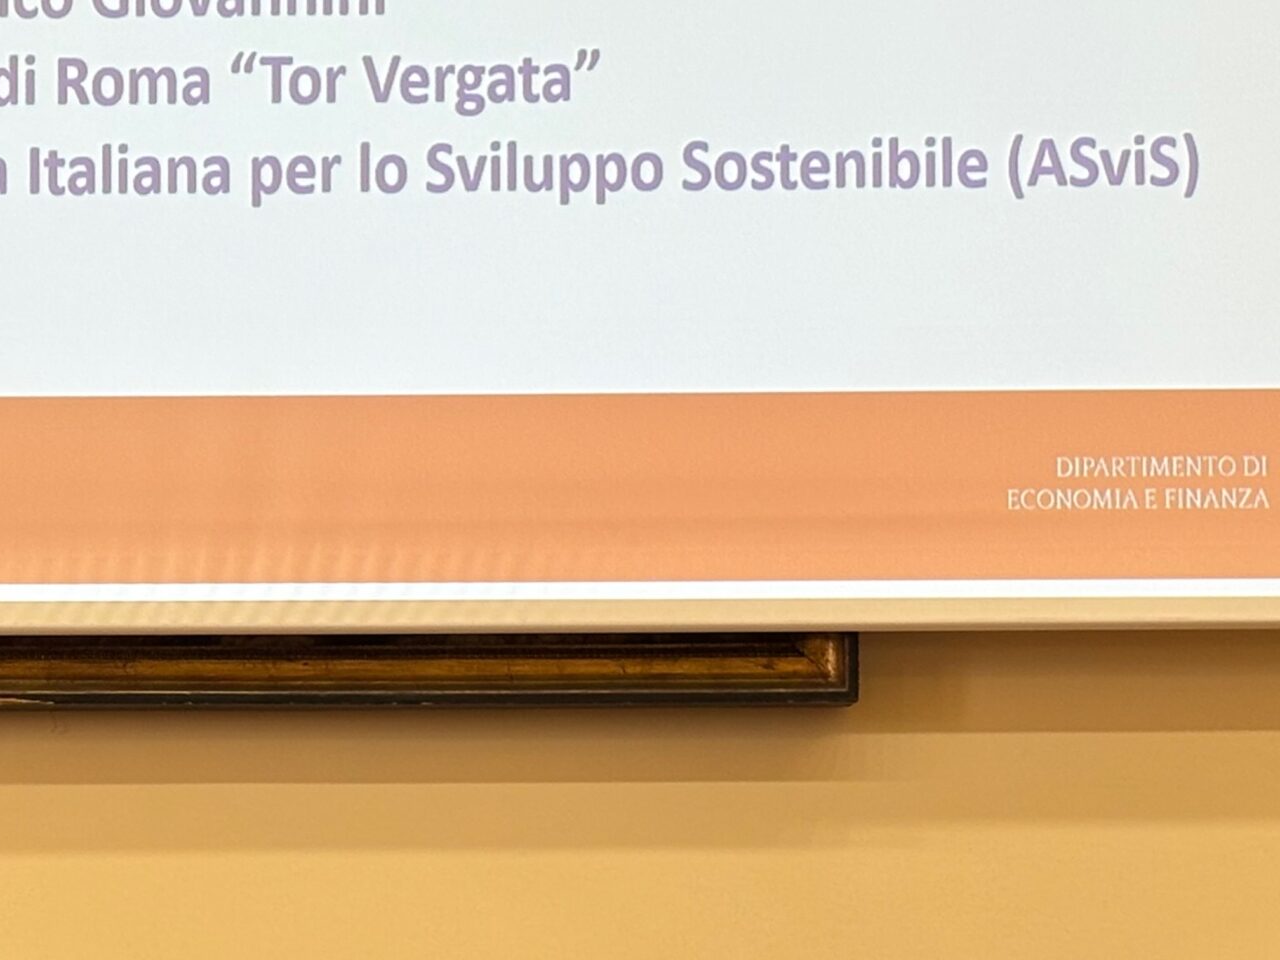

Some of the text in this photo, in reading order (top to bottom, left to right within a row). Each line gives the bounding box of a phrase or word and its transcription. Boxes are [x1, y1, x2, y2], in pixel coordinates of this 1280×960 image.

[58, 58, 212, 108] Roma
[231, 52, 348, 107] “Tor
[362, 48, 602, 118] Vergata”
[30, 144, 232, 198] Italiana
[252, 155, 344, 210] per
[360, 142, 409, 196] lo
[426, 141, 665, 207] Sviluppo
[682, 137, 990, 193] Sostenibile
[1009, 133, 1201, 201] (ASviS)
[1056, 456, 1268, 478] DIPARTIMENTO DI
[1007, 488, 1270, 511] ECONOMIA E FINANZA
